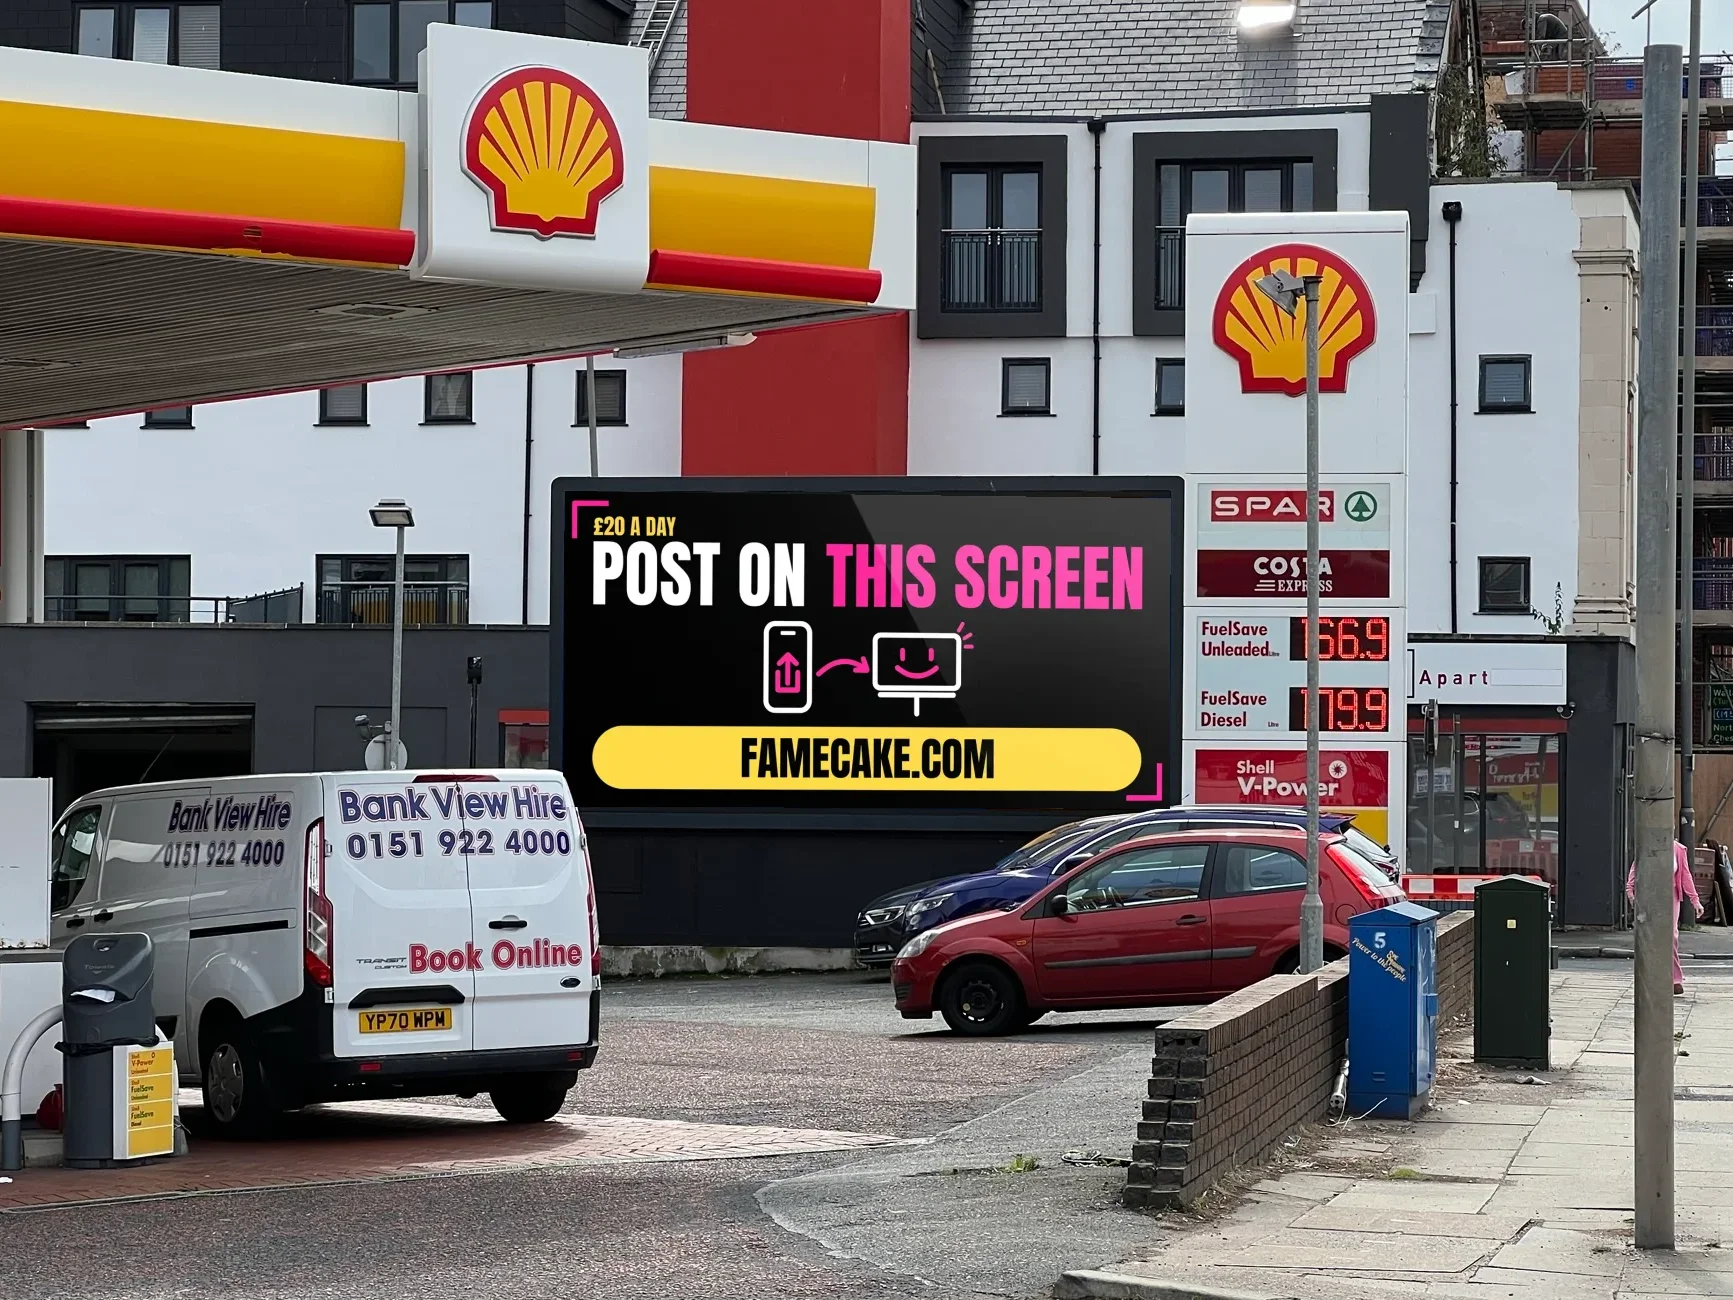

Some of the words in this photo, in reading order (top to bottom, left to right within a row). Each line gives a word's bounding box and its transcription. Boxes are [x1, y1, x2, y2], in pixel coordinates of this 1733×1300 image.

[1215, 497, 1331, 516] SPAR
[593, 516, 625, 536] £20
[630, 516, 641, 536] A
[646, 516, 676, 536] DAY
[593, 541, 721, 606] POST
[739, 542, 805, 607] ON
[826, 543, 936, 609] THIS
[955, 545, 1143, 610] SCREEN
[1278, 580, 1333, 592] EXPRSS
[1202, 621, 1268, 636] FuelSave
[1202, 641, 1269, 657] Unleaded
[1419, 669, 1488, 689] Apart
[1201, 690, 1267, 706] FuelSave
[1200, 711, 1247, 727] Diesel
[741, 737, 995, 779] FAMECAKE.COM
[1237, 760, 1274, 774] Shell
[1237, 776, 1339, 796] V-Power
[167, 799, 213, 833] Bank
[213, 795, 257, 832] View
[253, 794, 292, 831] Hire
[339, 787, 431, 824] Bank
[429, 784, 508, 820] View
[511, 785, 568, 821] Hire
[163, 841, 200, 868] 0151
[206, 840, 237, 867] 922
[240, 839, 285, 867] 4000
[346, 830, 424, 860] 0151
[437, 829, 494, 856] 922
[504, 828, 571, 855] 4000
[1374, 931, 1386, 949] 5
[409, 941, 484, 974] Book
[492, 937, 583, 970] Online
[1352, 937, 1371, 955] Power
[1370, 952, 1378, 960] to
[1385, 965, 1407, 983] people
[366, 1012, 409, 1031] YP70
[413, 1010, 445, 1028] WPM
[131, 1085, 154, 1093] FuelSave
[131, 1110, 154, 1120] FuelSave
